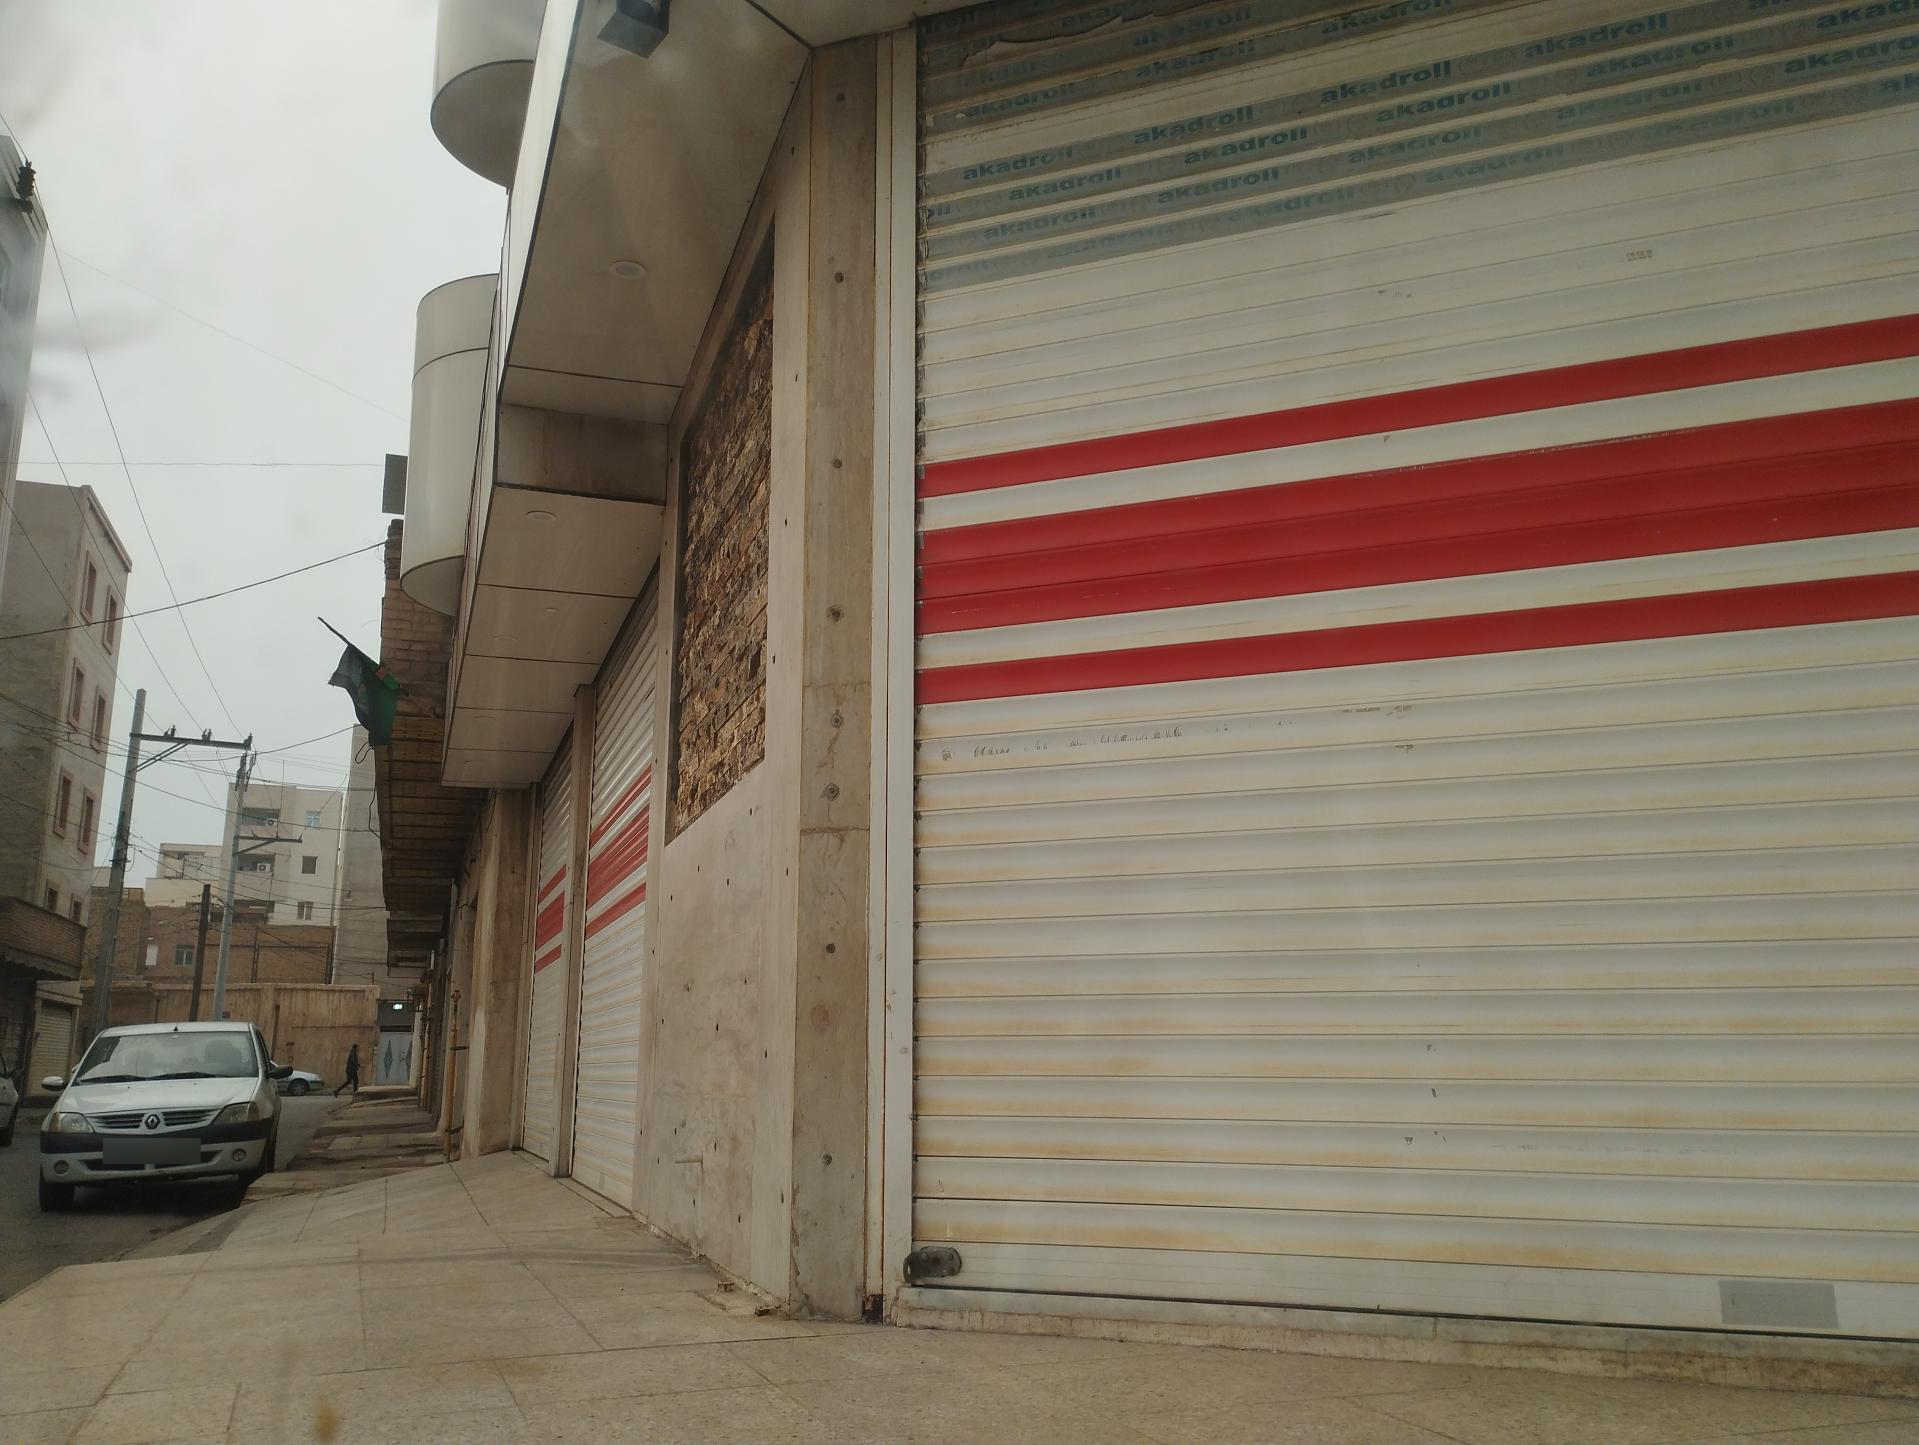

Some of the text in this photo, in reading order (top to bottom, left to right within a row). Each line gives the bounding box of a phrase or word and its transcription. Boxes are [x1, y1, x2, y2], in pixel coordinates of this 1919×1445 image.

[963, 12, 1668, 180] akadroll akadroll akadroll akadroll
[1007, 166, 1122, 201] akadroll
[1184, 126, 1308, 164] akadroll
[1376, 81, 1512, 123] akadroll
[983, 205, 1097, 240] akadroll
[1157, 166, 1279, 204] akadroll
